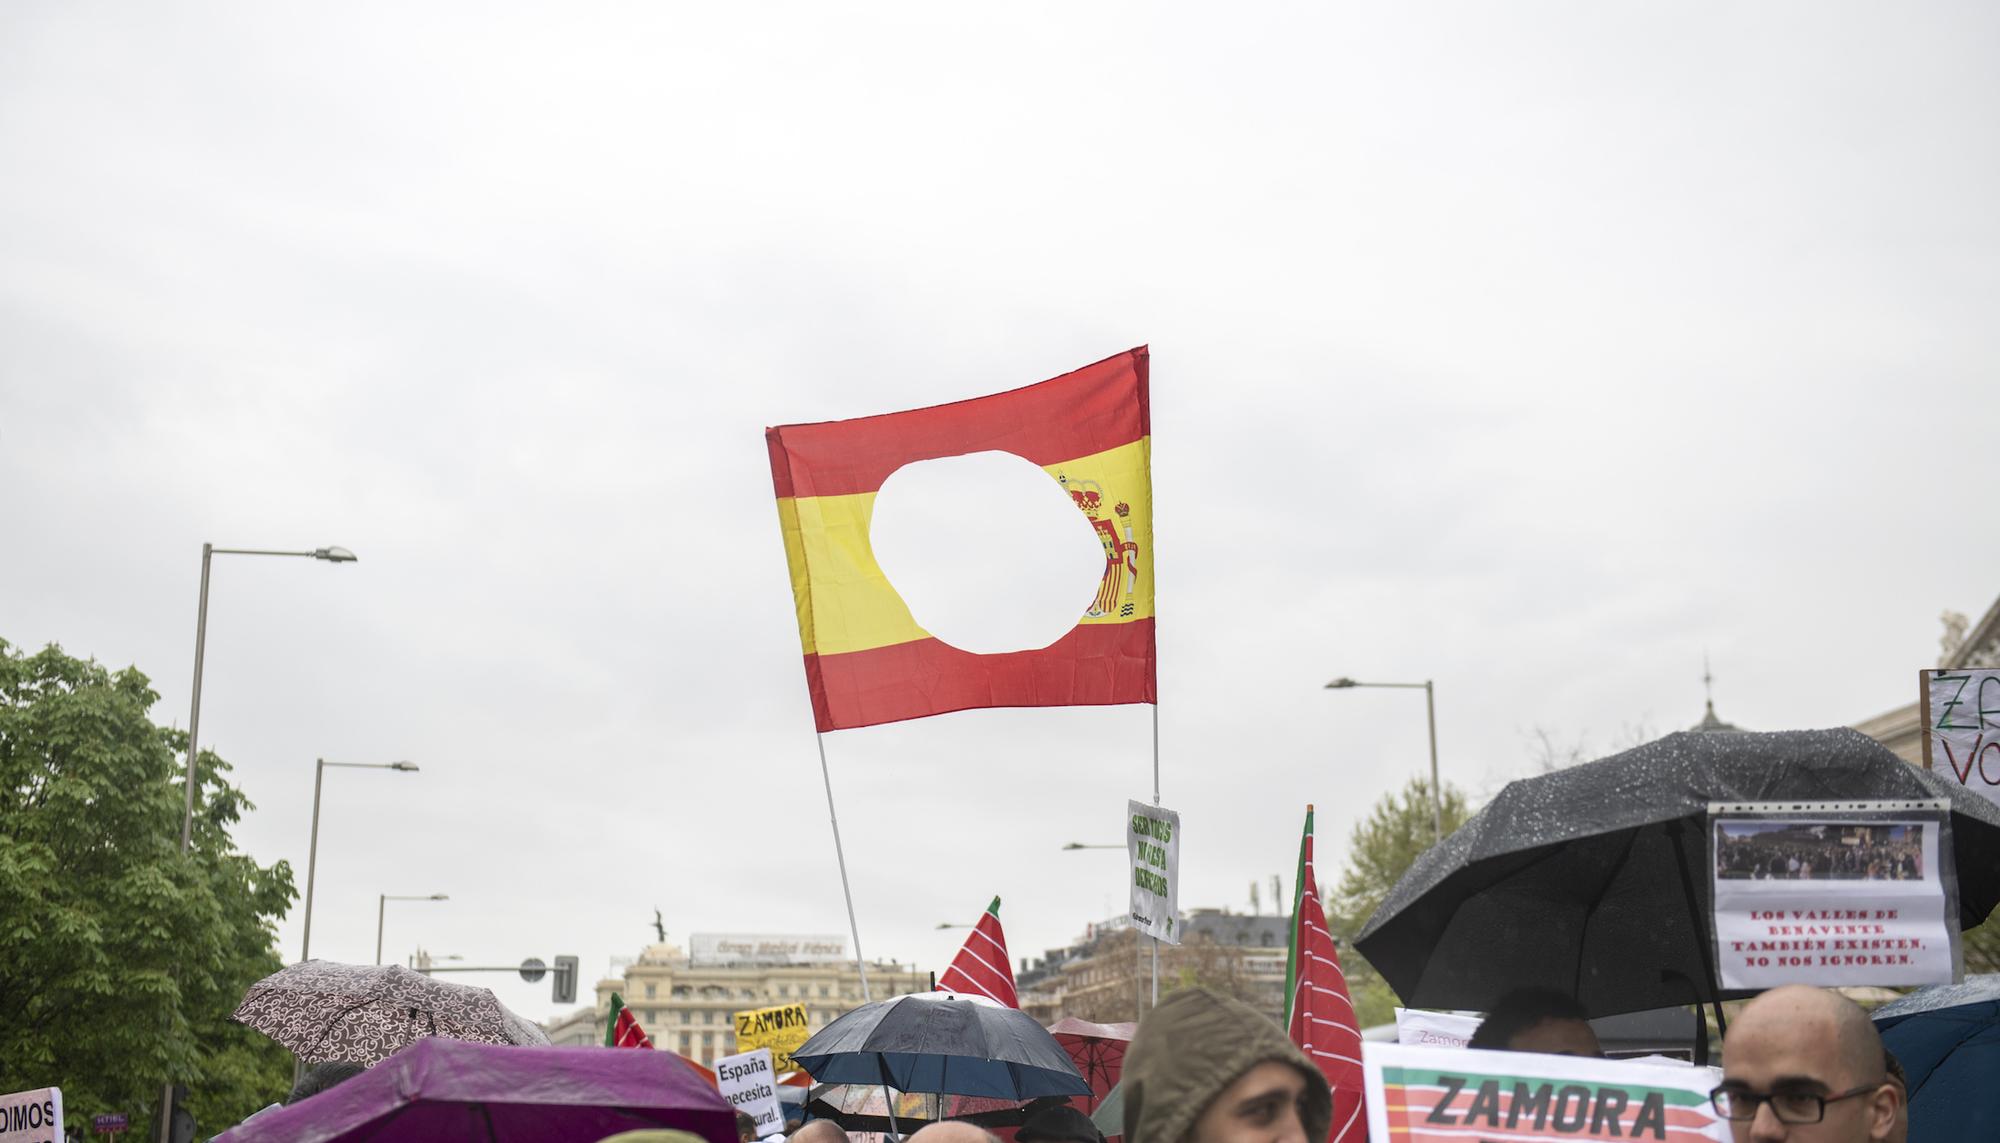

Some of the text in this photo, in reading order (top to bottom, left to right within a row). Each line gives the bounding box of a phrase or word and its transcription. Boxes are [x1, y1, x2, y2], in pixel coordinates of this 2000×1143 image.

[1132, 814, 1150, 836] SER
[1147, 843, 1166, 871] RESA
[1135, 867, 1168, 898] DERCHOS
[1751, 909, 1898, 921] LOS VALLES DE
[1768, 925, 1885, 936] BENAVENTE
[1731, 938, 1926, 952] TAMBIÉN EXISTEN,
[1745, 954, 1914, 967] NO NOS IGNOREN.
[739, 1006, 806, 1036] ZAMORA
[1419, 1030, 1471, 1048] Zamor
[719, 1057, 767, 1082] España
[725, 1083, 772, 1106] necesita
[1426, 1075, 1666, 1141] ZAMORA
